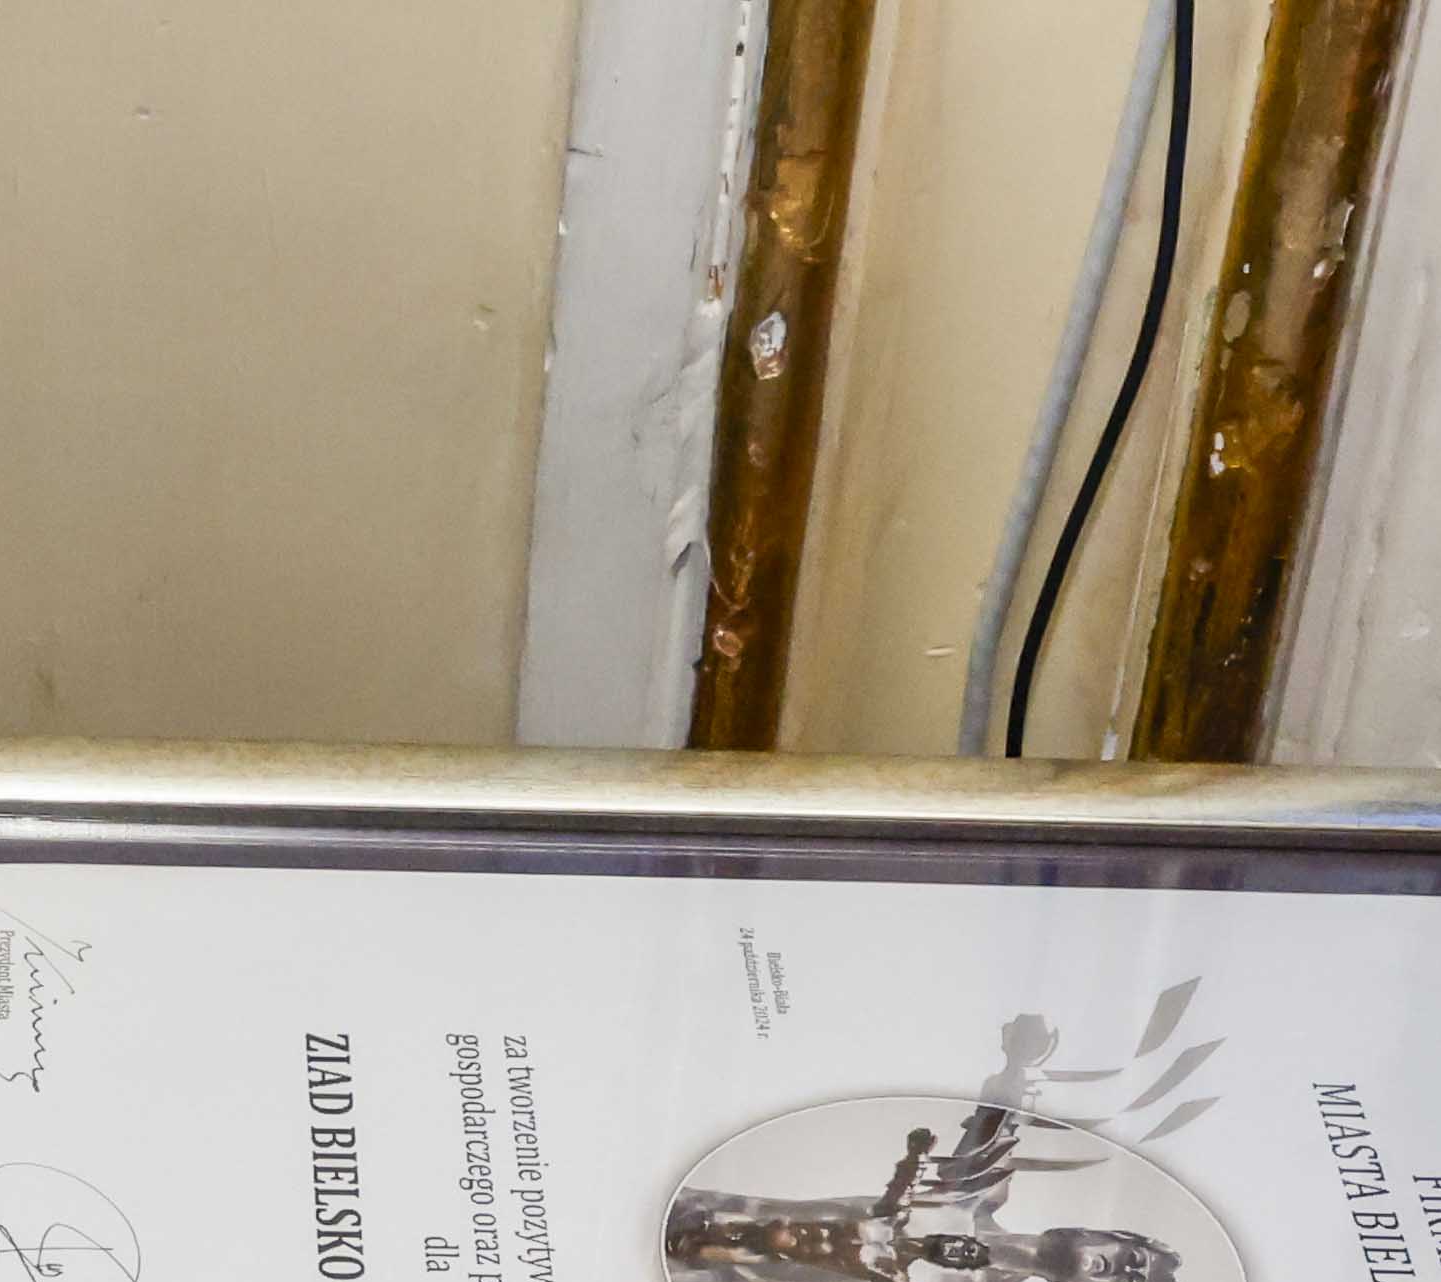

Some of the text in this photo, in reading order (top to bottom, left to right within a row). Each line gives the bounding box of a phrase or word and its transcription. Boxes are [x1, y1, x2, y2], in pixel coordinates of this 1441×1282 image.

[306, 1033, 353, 1114] ZIAD
[503, 1035, 529, 1059] za
[446, 1034, 494, 1205] gospodarczego
[472, 1212, 501, 1265] oraz
[507, 1067, 548, 1181] tworzenie
[1313, 1083, 1390, 1200] MIASTA
[423, 1236, 459, 1273] dla
